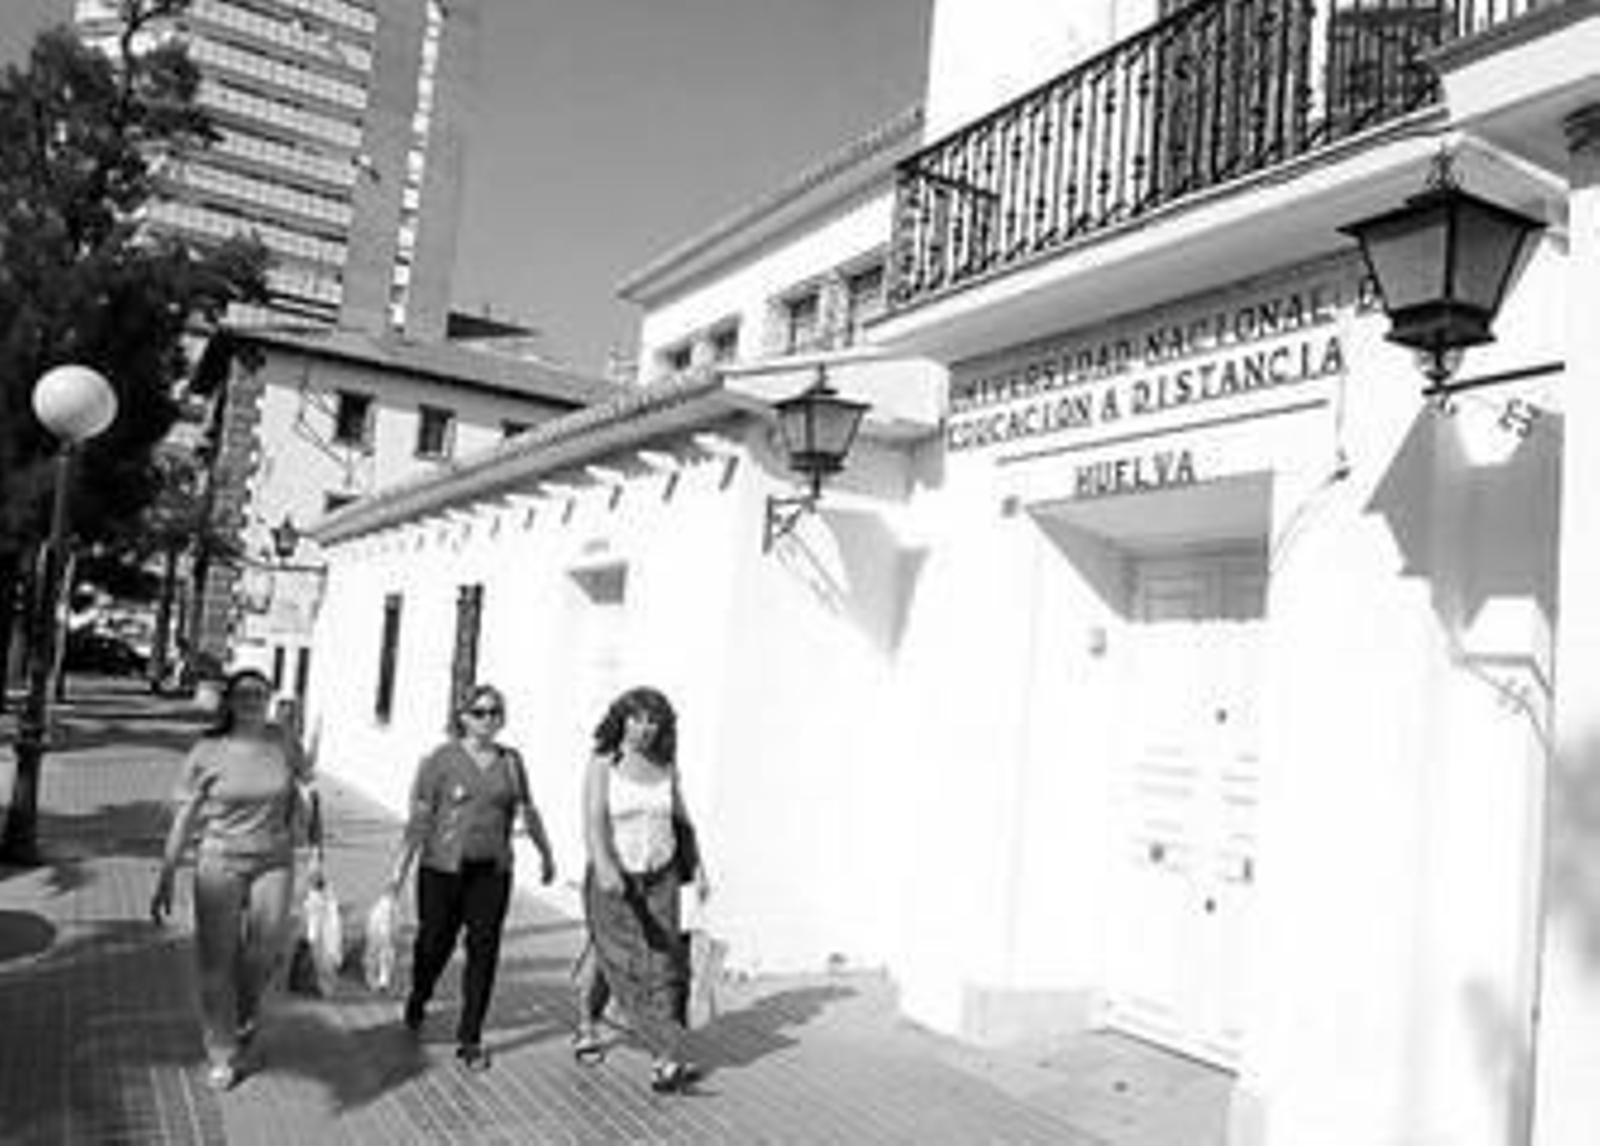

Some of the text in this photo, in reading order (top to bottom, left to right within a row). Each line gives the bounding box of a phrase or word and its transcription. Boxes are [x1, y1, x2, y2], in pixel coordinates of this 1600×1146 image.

[1144, 283, 1337, 367] NACIONAL
[1101, 386, 1122, 421] A
[1132, 335, 1343, 415] DISTANCIA
[1073, 449, 1197, 499] HUELVA
